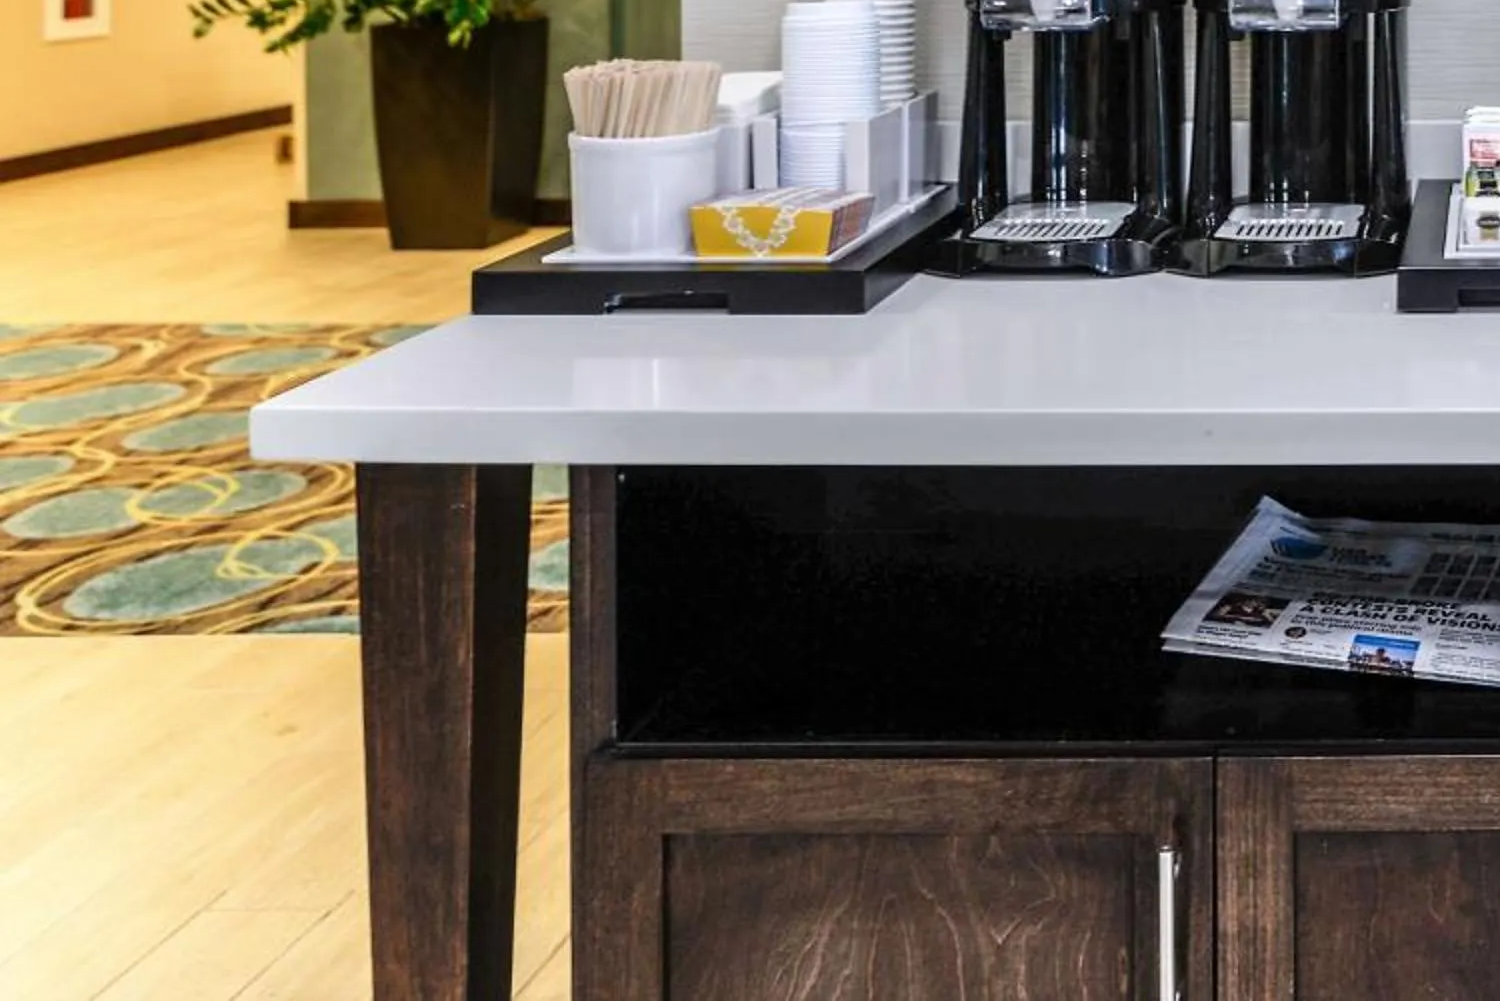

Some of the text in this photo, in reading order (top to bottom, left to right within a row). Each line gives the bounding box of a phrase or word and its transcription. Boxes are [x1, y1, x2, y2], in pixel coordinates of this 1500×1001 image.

[1320, 606, 1387, 620] CLASH
[1393, 613, 1420, 622] OF
[1413, 607, 1491, 622] REVEAL
